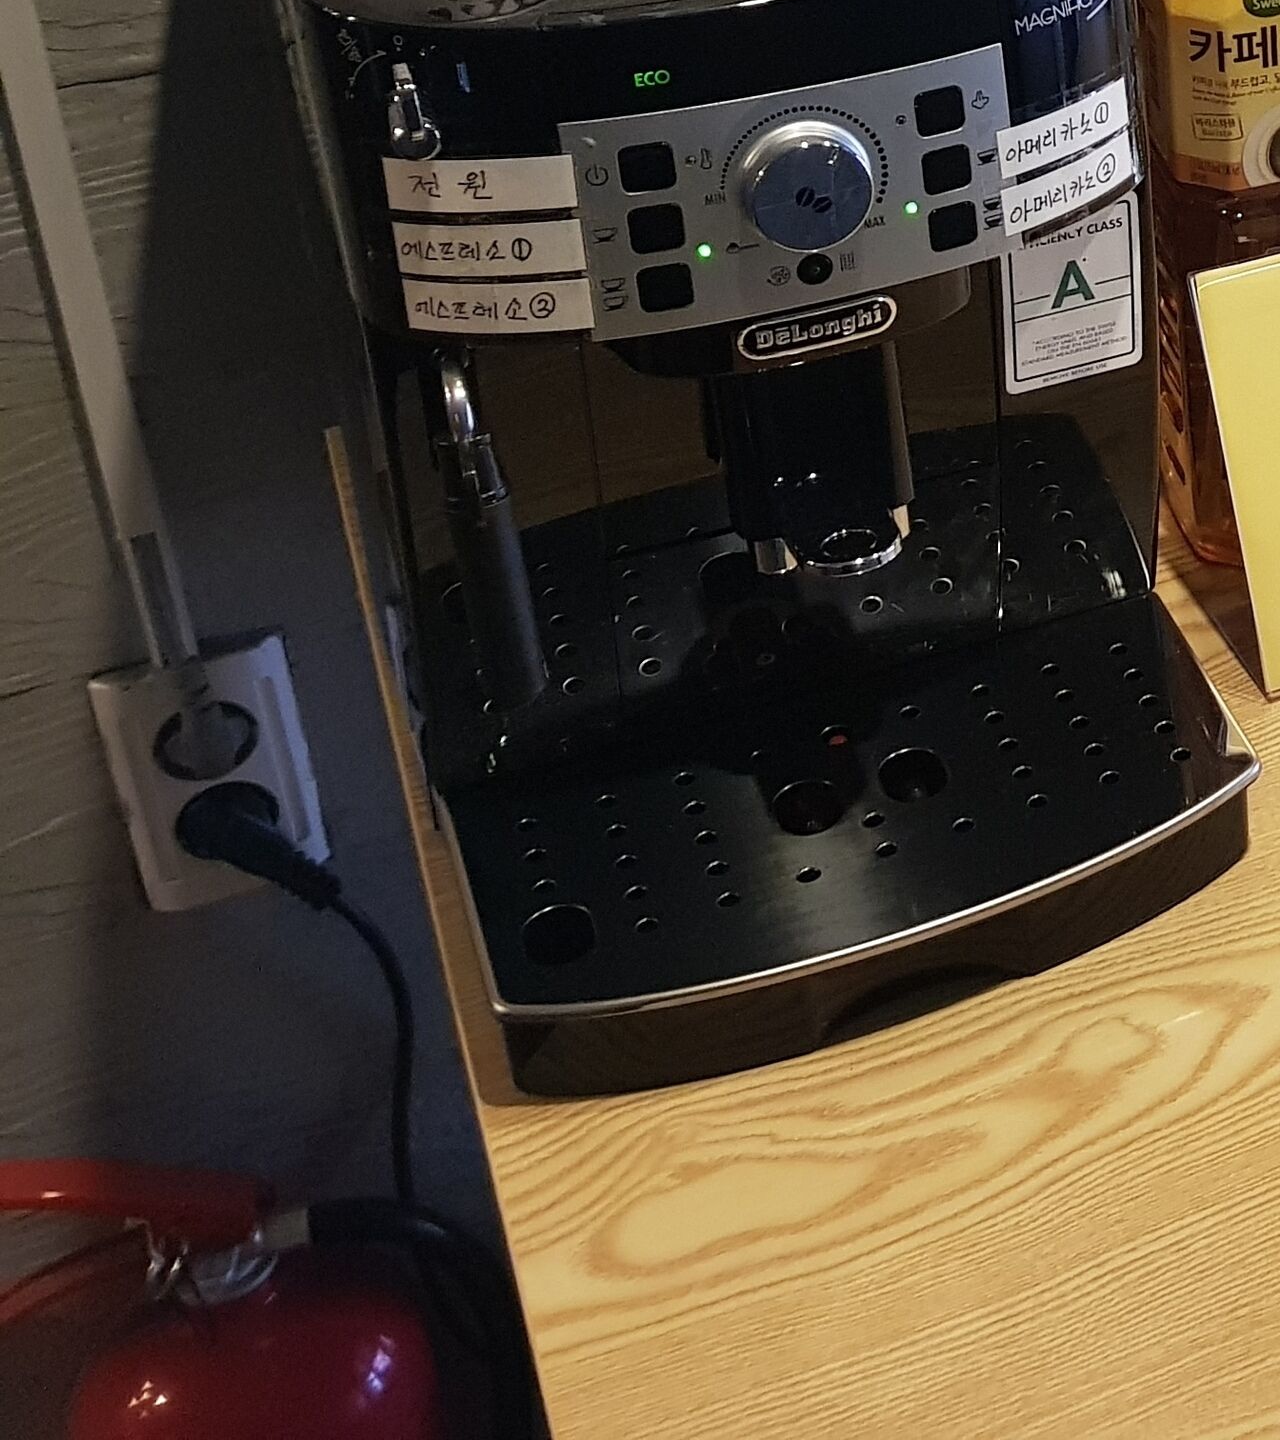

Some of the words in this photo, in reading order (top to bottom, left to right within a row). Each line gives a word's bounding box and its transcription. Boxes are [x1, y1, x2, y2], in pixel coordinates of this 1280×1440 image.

[633, 69, 671, 88] ECO
[704, 192, 727, 207] MIN
[863, 216, 887, 230] MAX
[1086, 216, 1123, 235] CLASS
[1051, 259, 1096, 310] A
